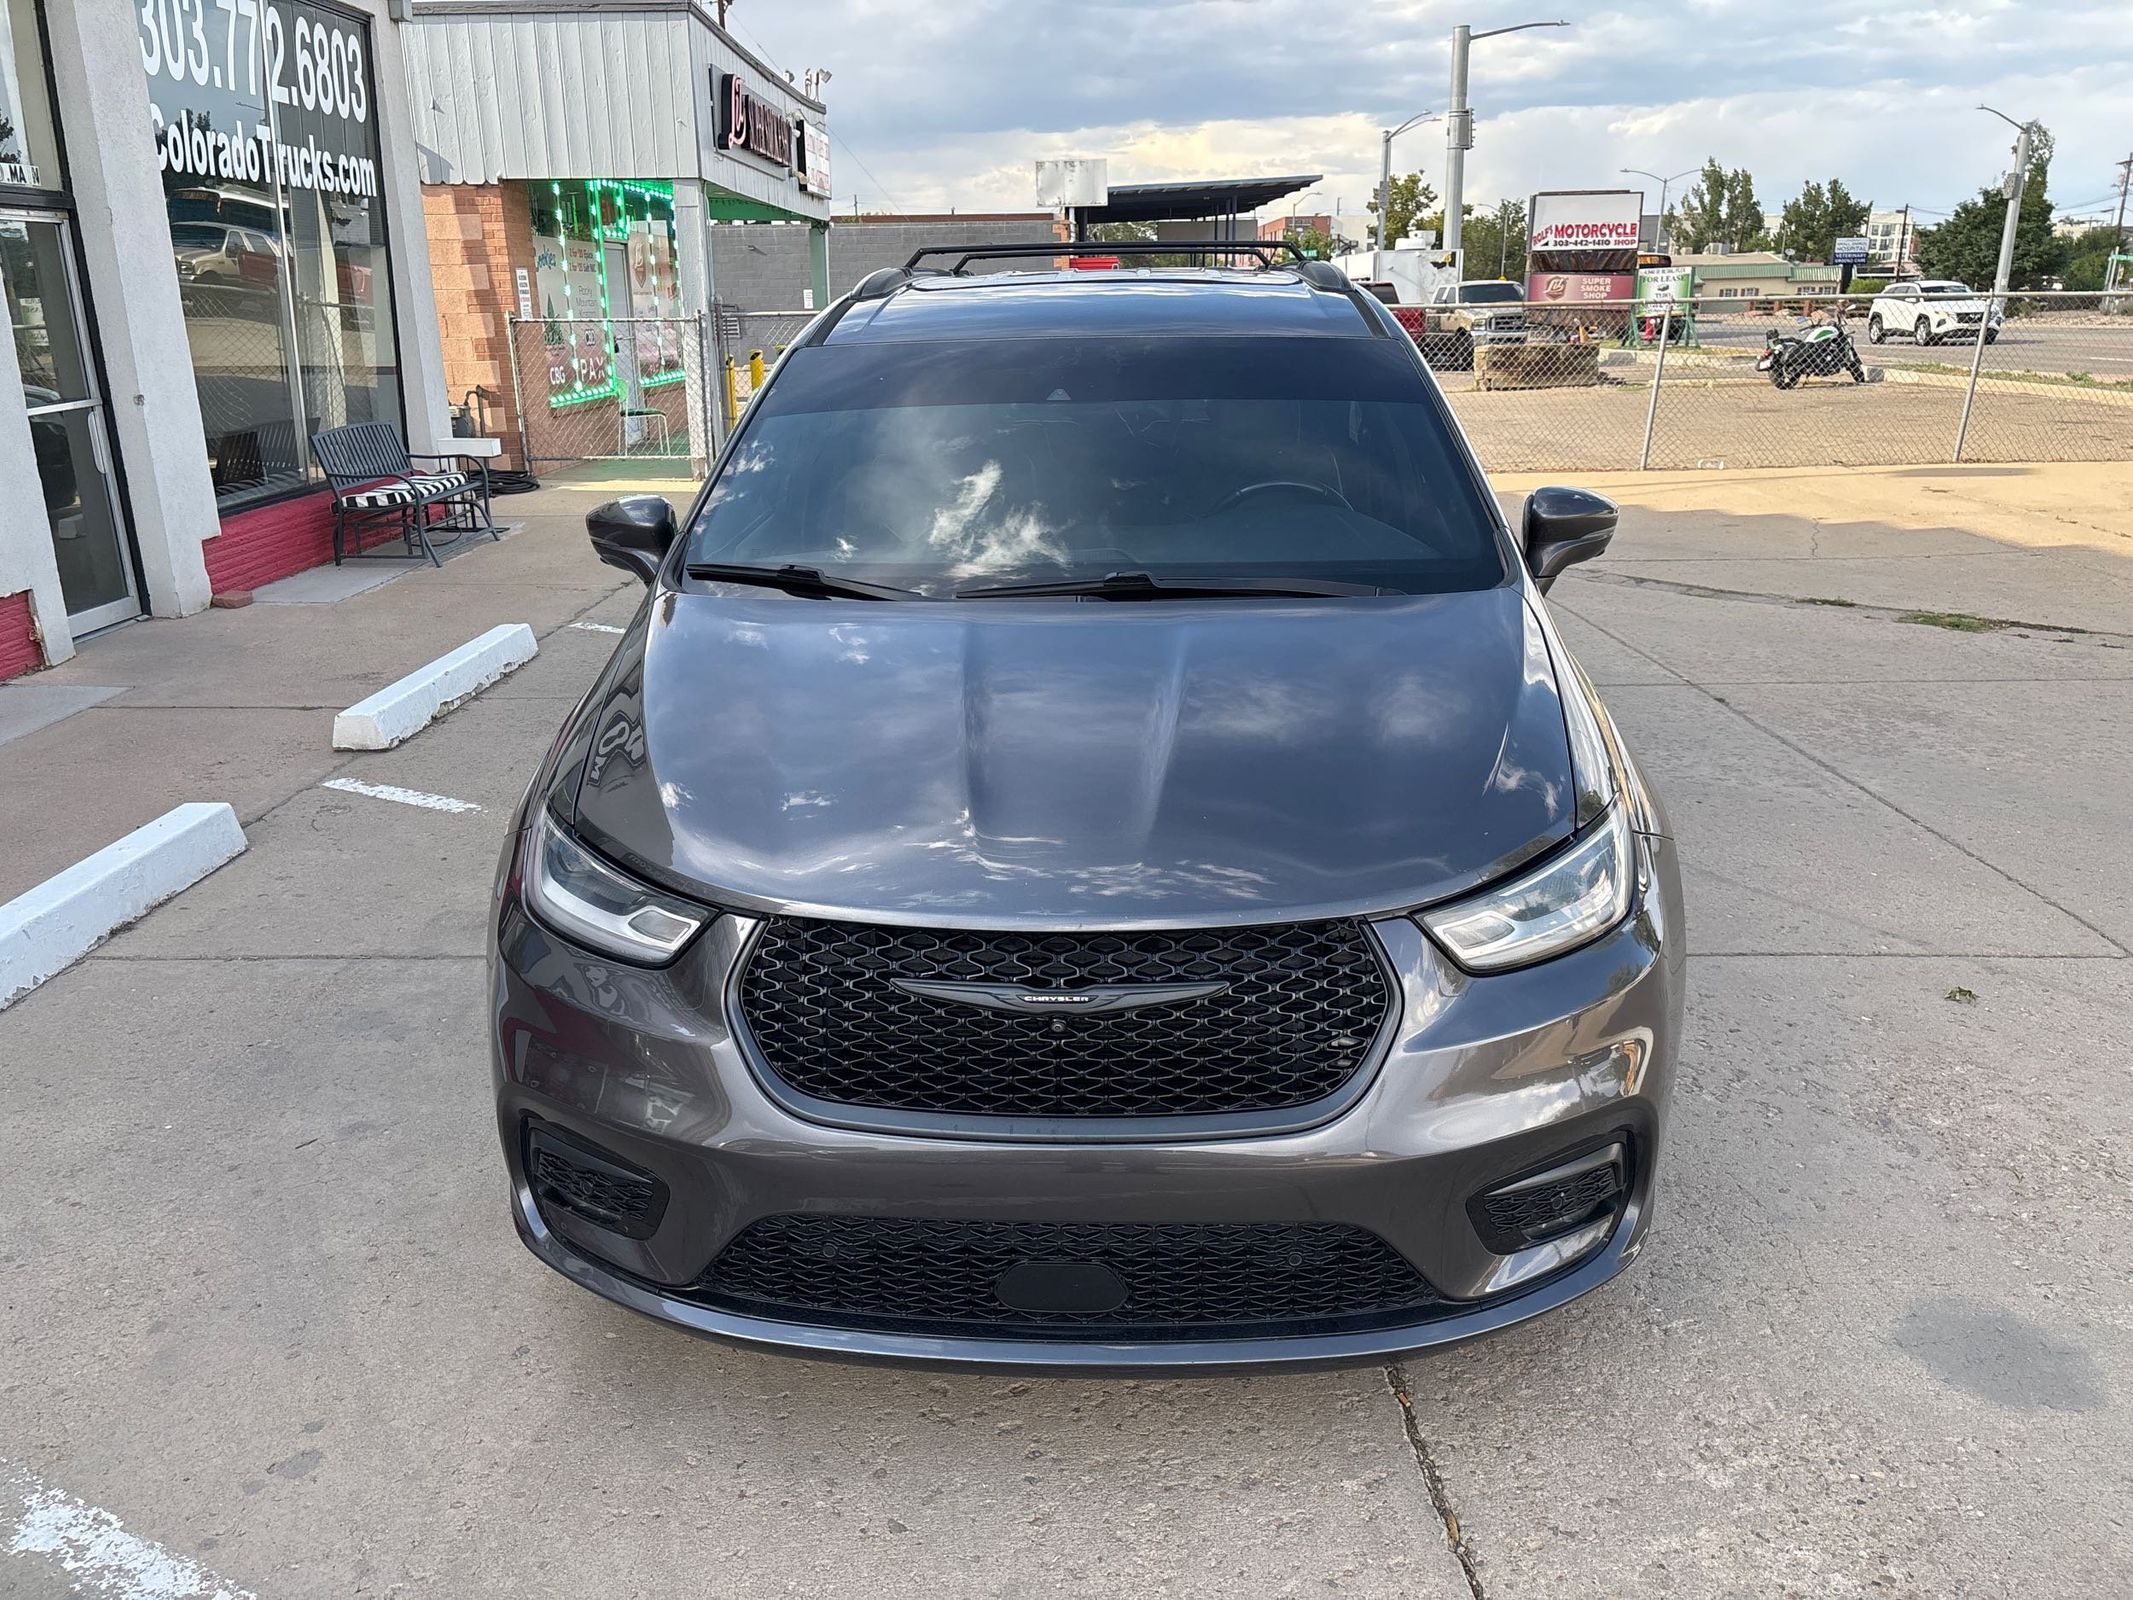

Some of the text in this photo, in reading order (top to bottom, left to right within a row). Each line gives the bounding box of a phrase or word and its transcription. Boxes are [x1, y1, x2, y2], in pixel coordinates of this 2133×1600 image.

[150, 102, 377, 197] ColoradoTrucks.com
[1554, 223, 1637, 238] MOTORCYCLE
[1582, 277, 1611, 285] SUPER
[1642, 275, 1659, 283] FOR
[580, 357, 605, 381] PAX
